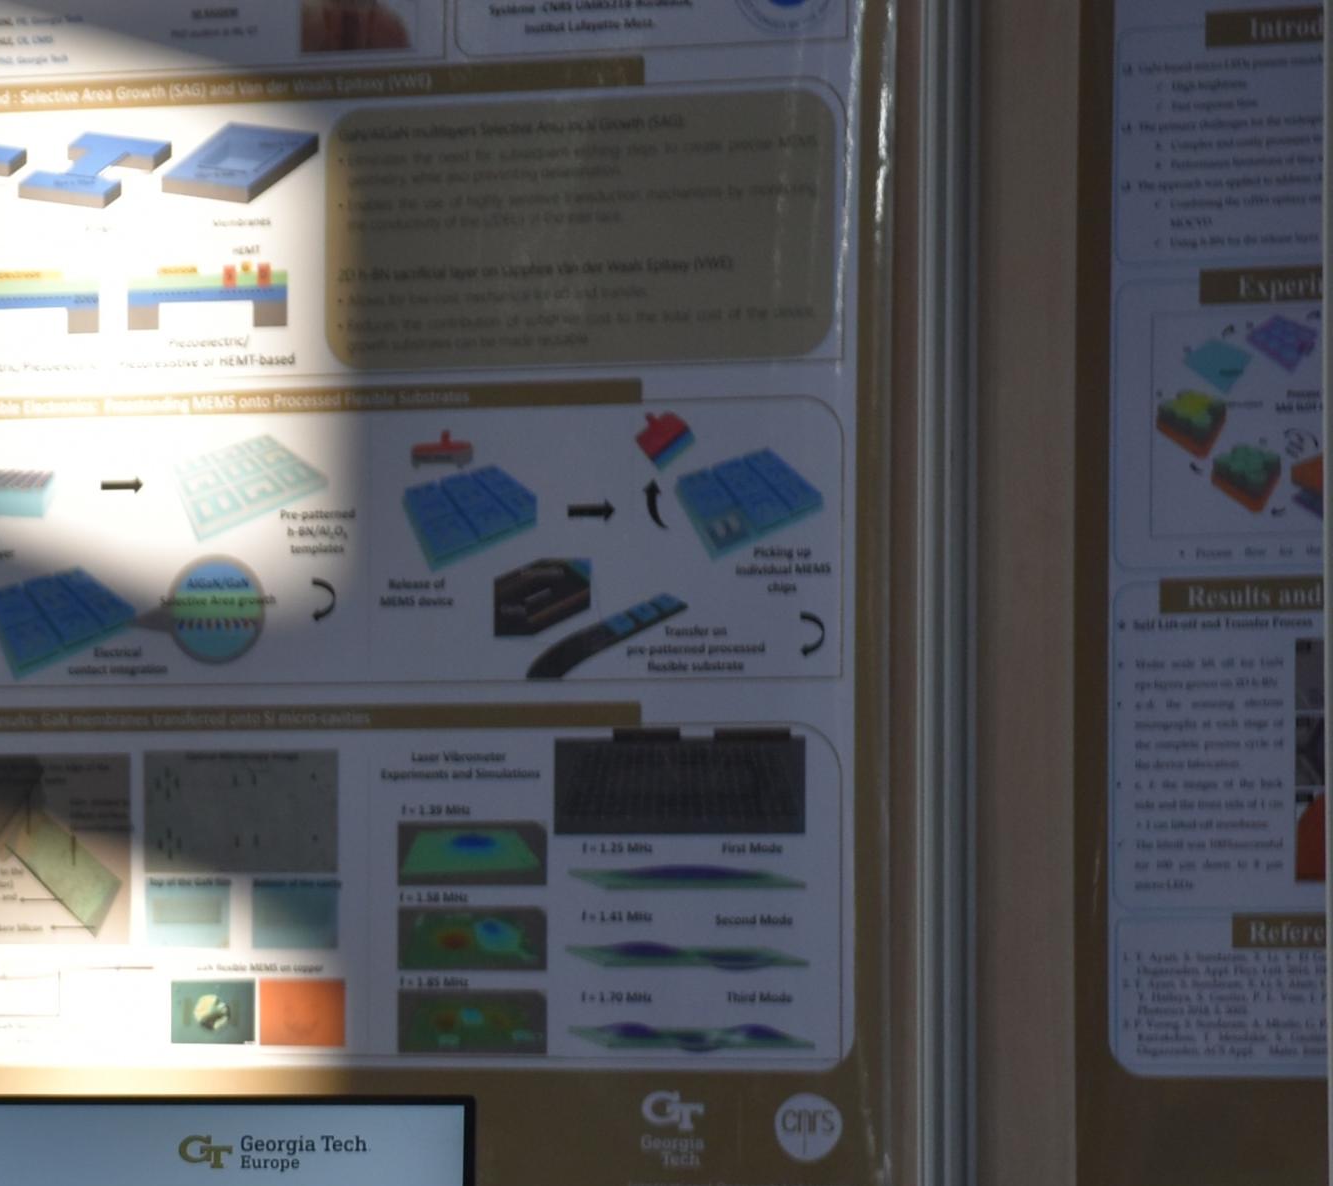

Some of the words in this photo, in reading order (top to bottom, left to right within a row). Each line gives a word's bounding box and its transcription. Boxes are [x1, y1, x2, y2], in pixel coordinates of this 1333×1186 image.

[1188, 583, 1271, 608] Results
[1278, 580, 1323, 606] and
[641, 1089, 705, 1132] GT
[178, 1134, 233, 1169] GT
[239, 1134, 316, 1157] Georgia
[319, 1134, 367, 1152] Tech
[239, 1154, 300, 1173] Europe
